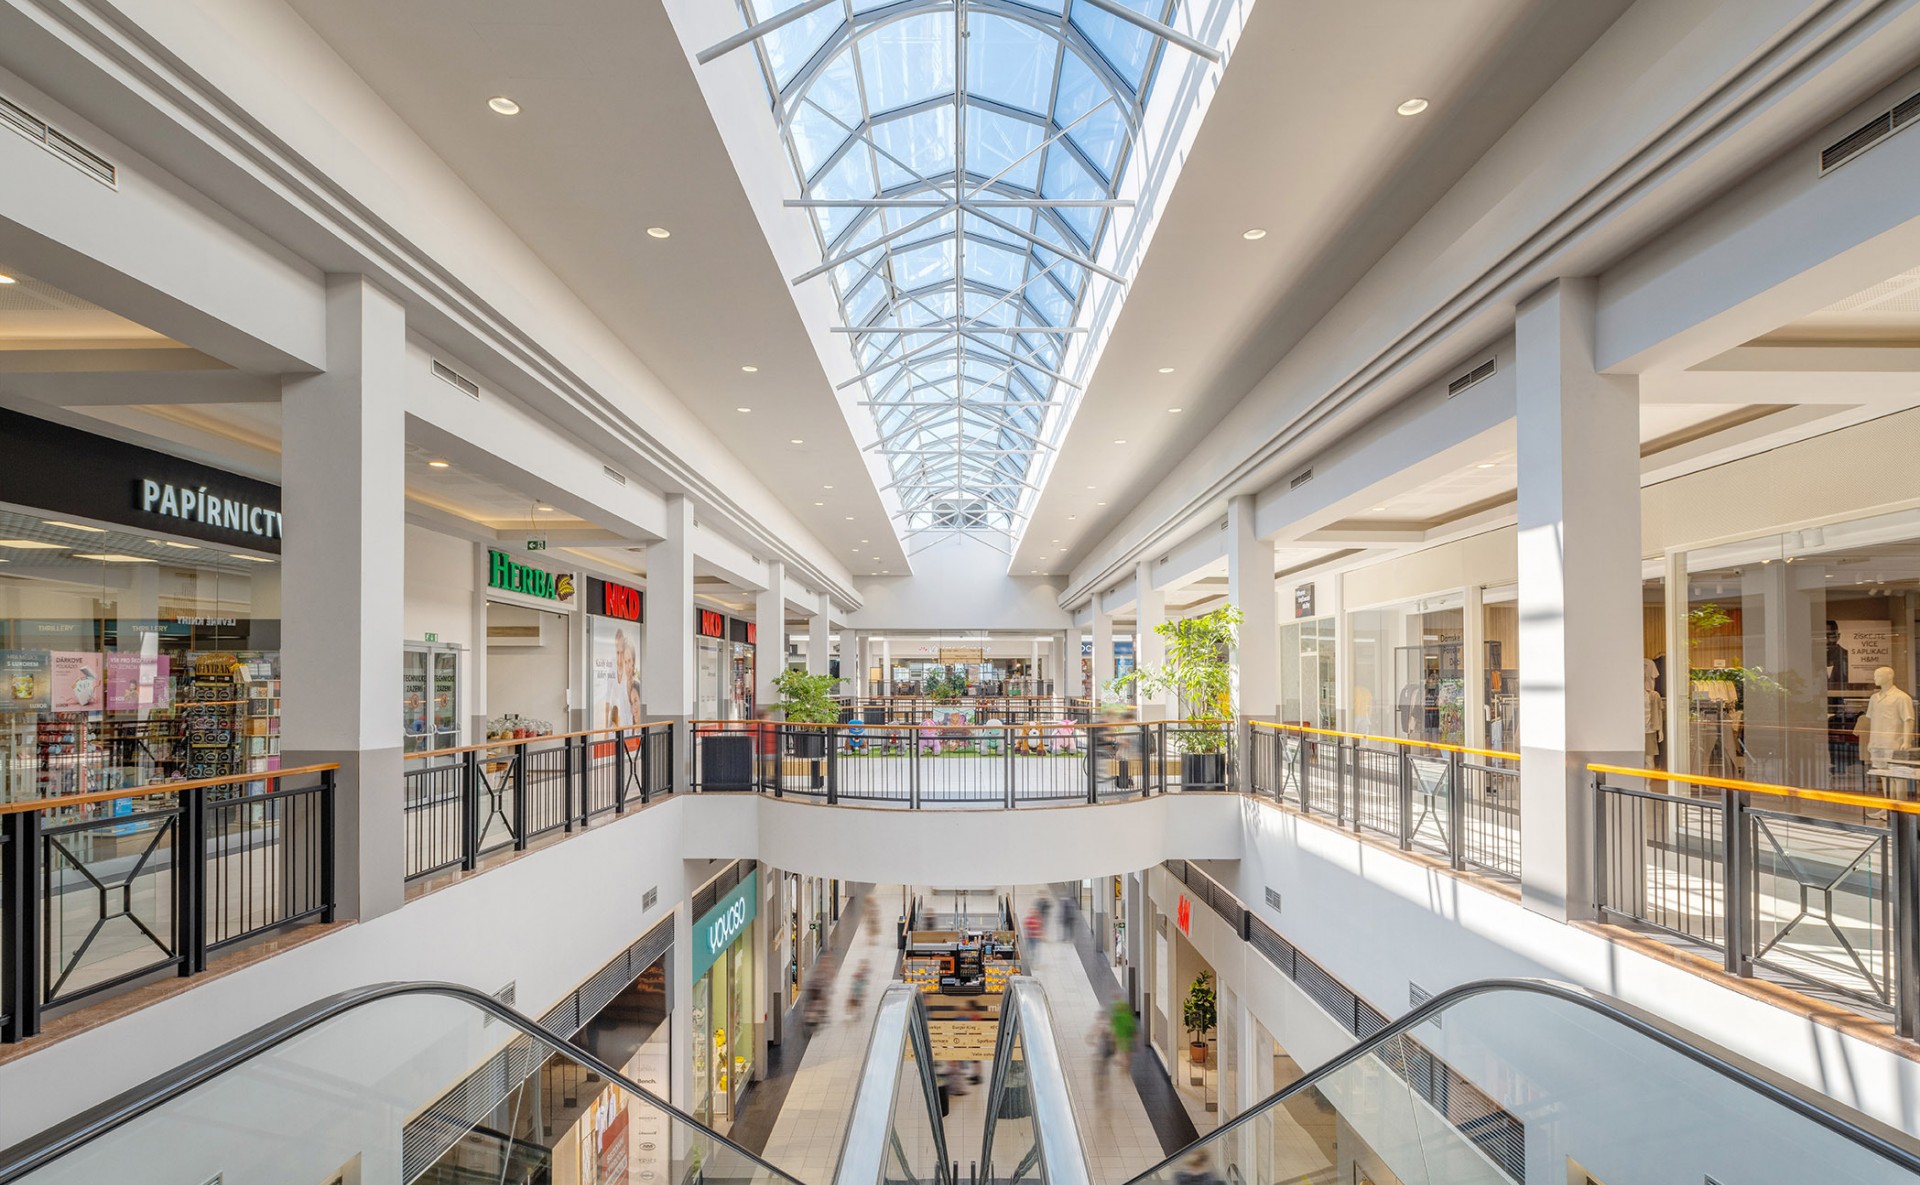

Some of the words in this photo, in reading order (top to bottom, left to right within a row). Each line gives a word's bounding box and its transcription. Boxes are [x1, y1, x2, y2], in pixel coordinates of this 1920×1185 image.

[488, 549, 557, 600] HERBA
[605, 581, 641, 620] NKD
[132, 625, 168, 633] THRILLERY
[702, 609, 722, 637] NKD
[1853, 632, 1886, 640] ZÍSKEJTE
[1861, 640, 1878, 648] VÍCE
